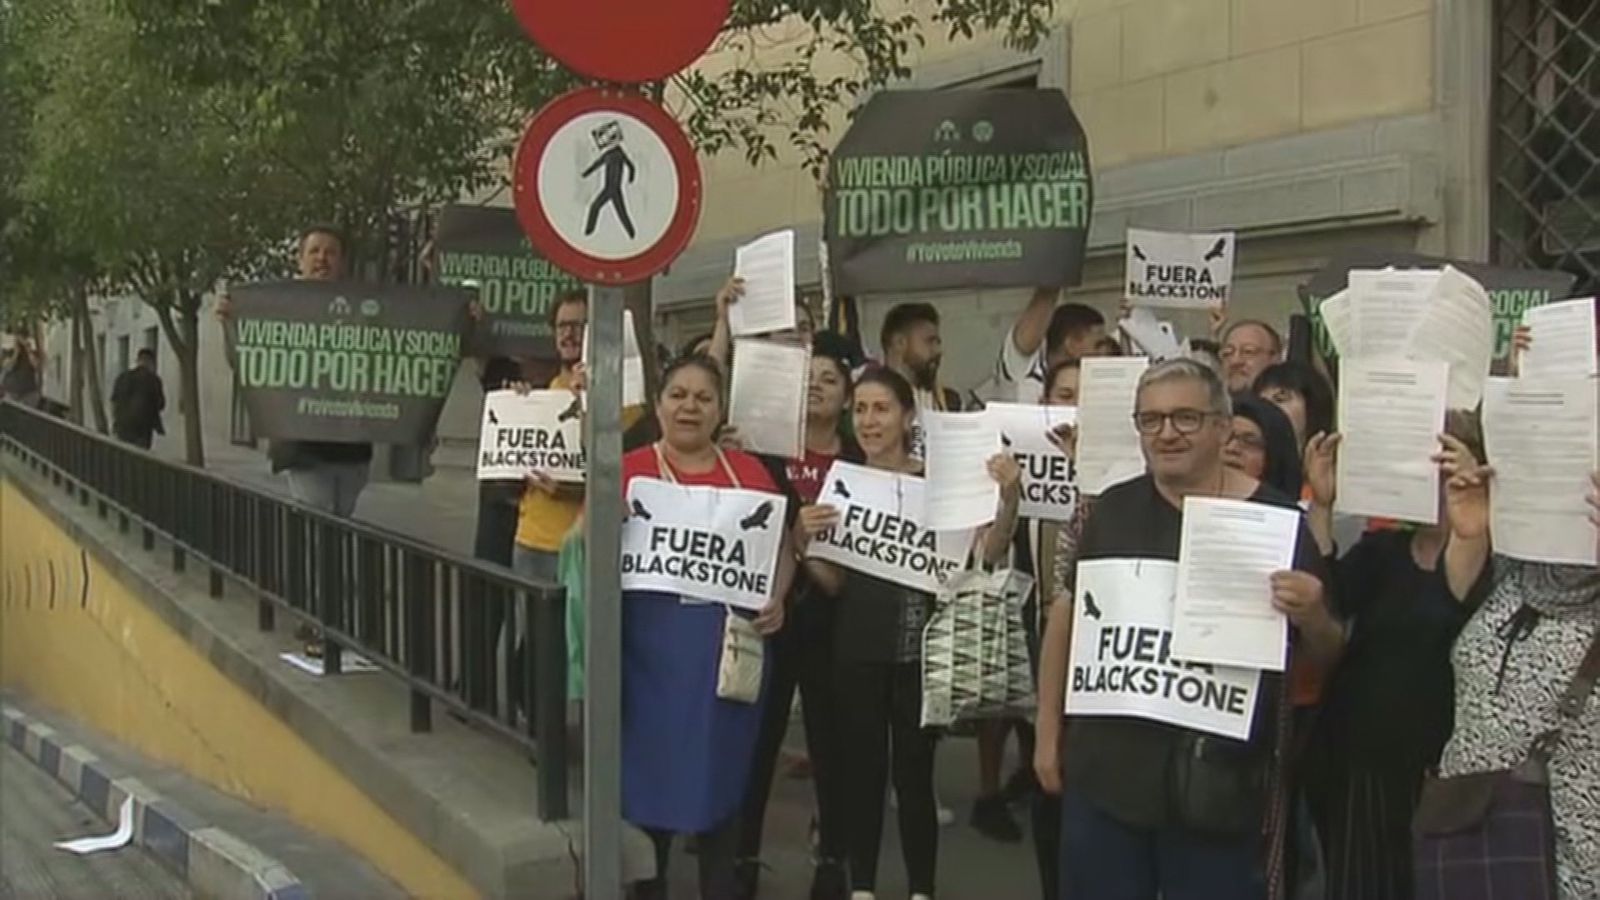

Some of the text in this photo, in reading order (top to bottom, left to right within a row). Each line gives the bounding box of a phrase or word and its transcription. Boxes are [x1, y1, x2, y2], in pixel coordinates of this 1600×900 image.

[836, 155, 924, 189] VIVIENDA
[926, 148, 1008, 186] PÚBLICA
[1007, 154, 1025, 180] Y
[835, 181, 1088, 237] TODO POR HACER
[438, 251, 511, 279] VIVIENDA
[1145, 264, 1213, 284] FUERA
[237, 318, 318, 349] VIVIENDA
[319, 318, 390, 353] PÚBLICA
[390, 329, 406, 353] Y
[235, 345, 309, 388] TODO
[310, 350, 370, 393] POR
[497, 428, 566, 450] FUERA
[651, 526, 746, 567] FUERA
[843, 503, 937, 553] FUERA
[621, 553, 769, 595] BLACKSTONE
[1073, 665, 1248, 716] BLACKSTONE
